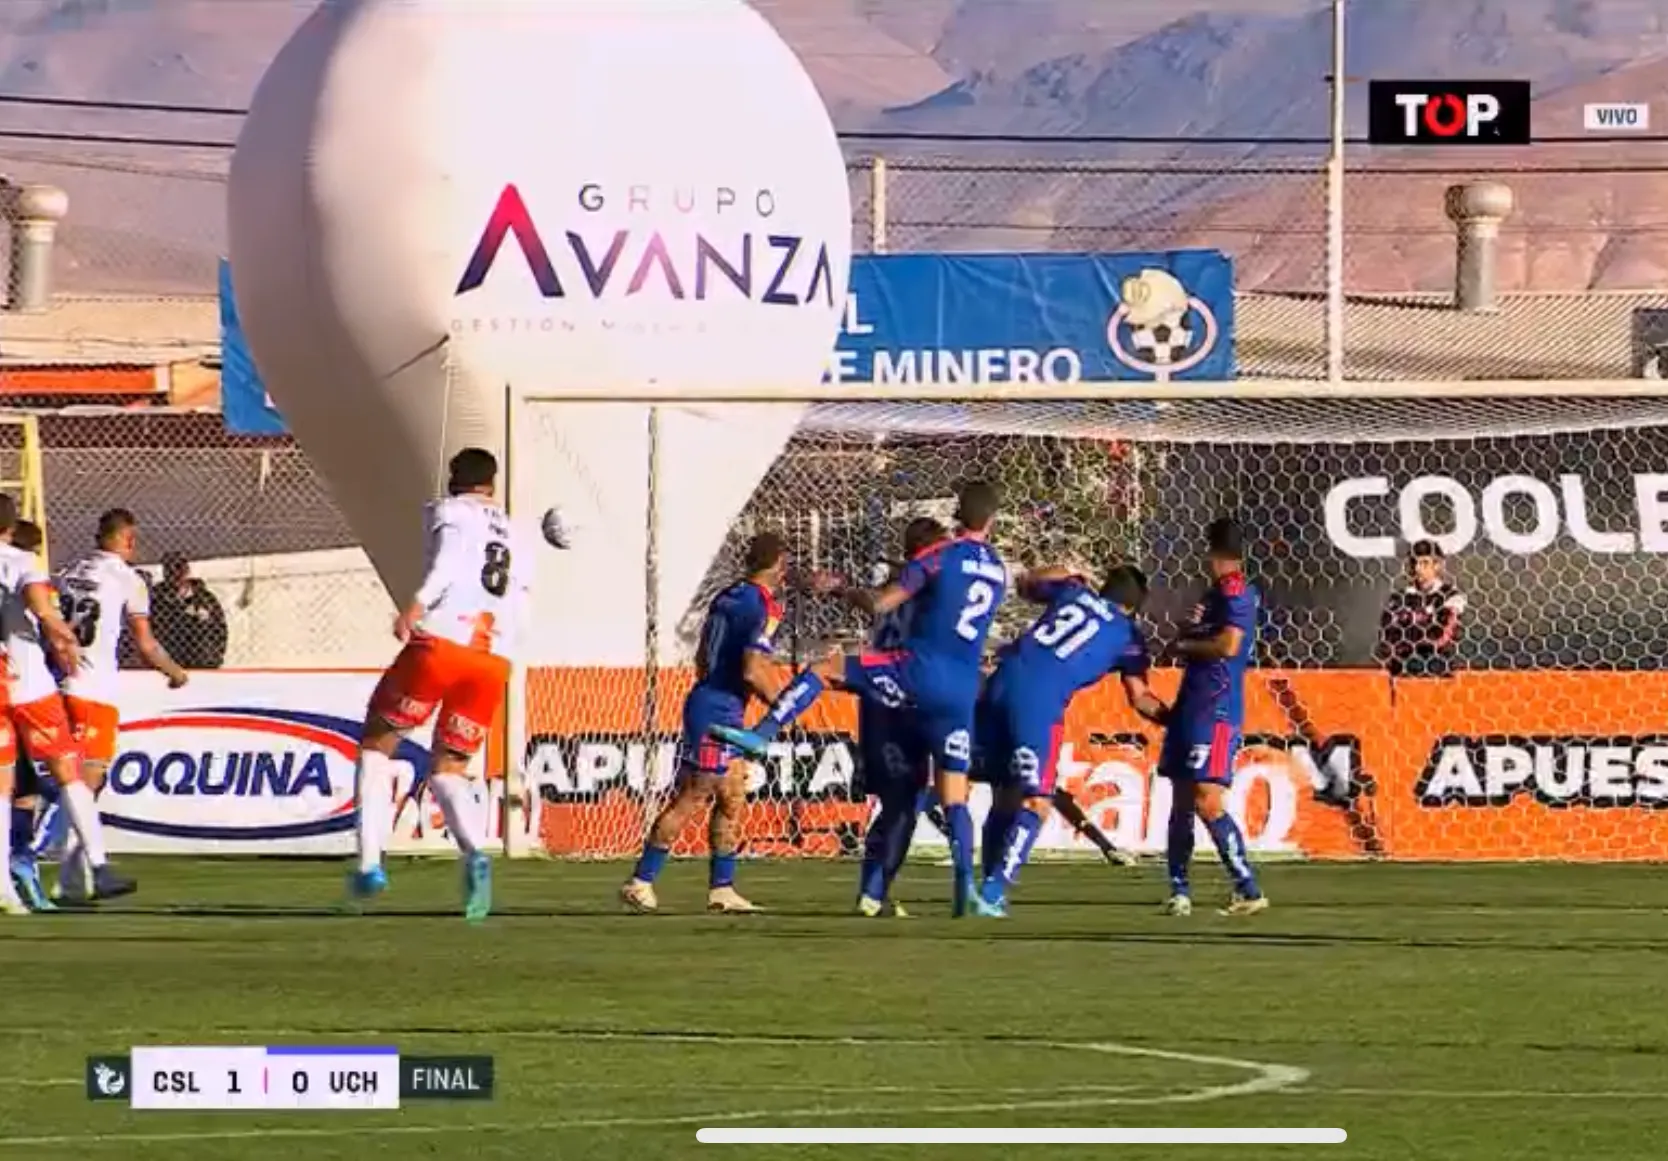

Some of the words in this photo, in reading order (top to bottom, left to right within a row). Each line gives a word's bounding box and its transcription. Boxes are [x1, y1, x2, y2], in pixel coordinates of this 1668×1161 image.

[578, 183, 776, 217] GRUPO
[454, 183, 834, 307] AVANZA
[873, 350, 1082, 382] MINERO
[481, 541, 511, 598] 8
[956, 580, 994, 641] 2
[1033, 604, 1101, 659] 31
[98, 751, 333, 796] OQUINA
